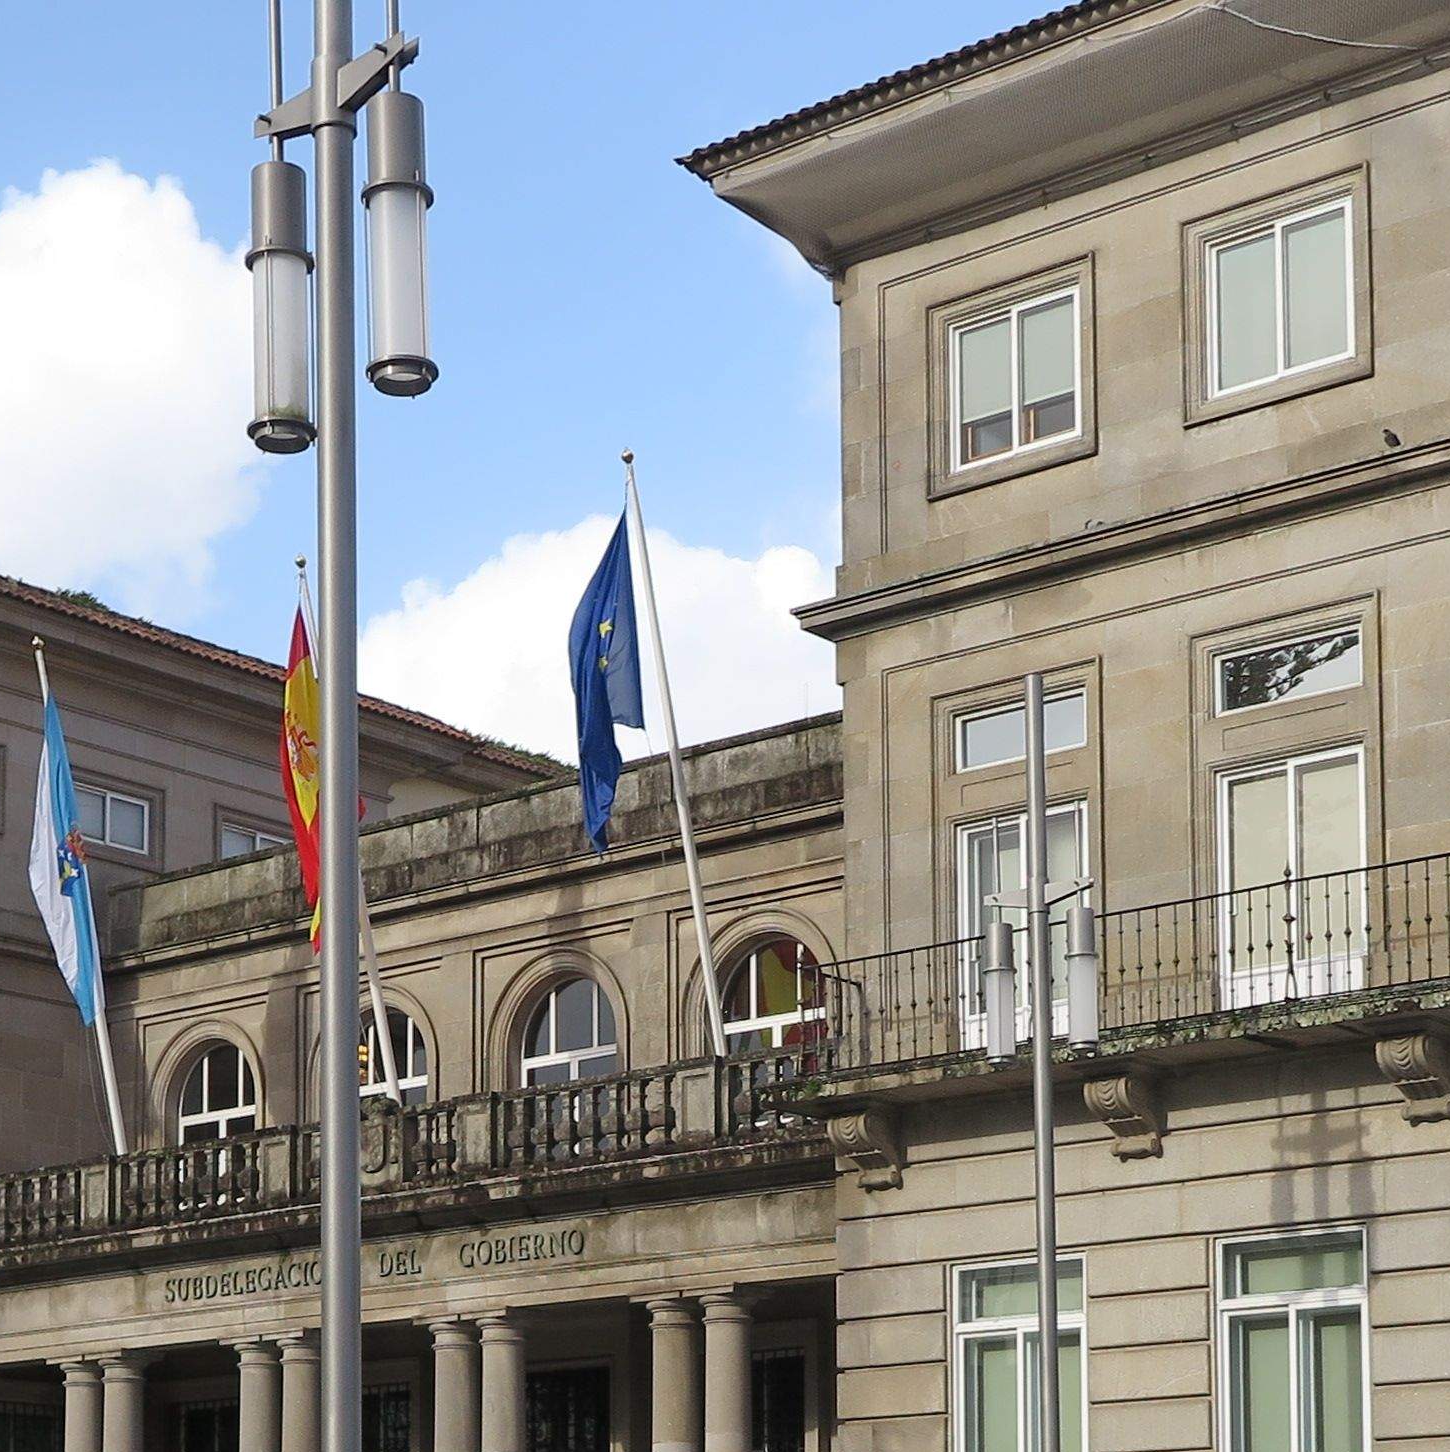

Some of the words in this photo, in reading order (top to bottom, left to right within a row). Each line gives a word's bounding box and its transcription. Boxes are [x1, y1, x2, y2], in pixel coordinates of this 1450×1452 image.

[164, 1261, 322, 1303] SUBDELEGACIO
[380, 1250, 422, 1278] DEL
[459, 1229, 586, 1269] GOBIERNO
